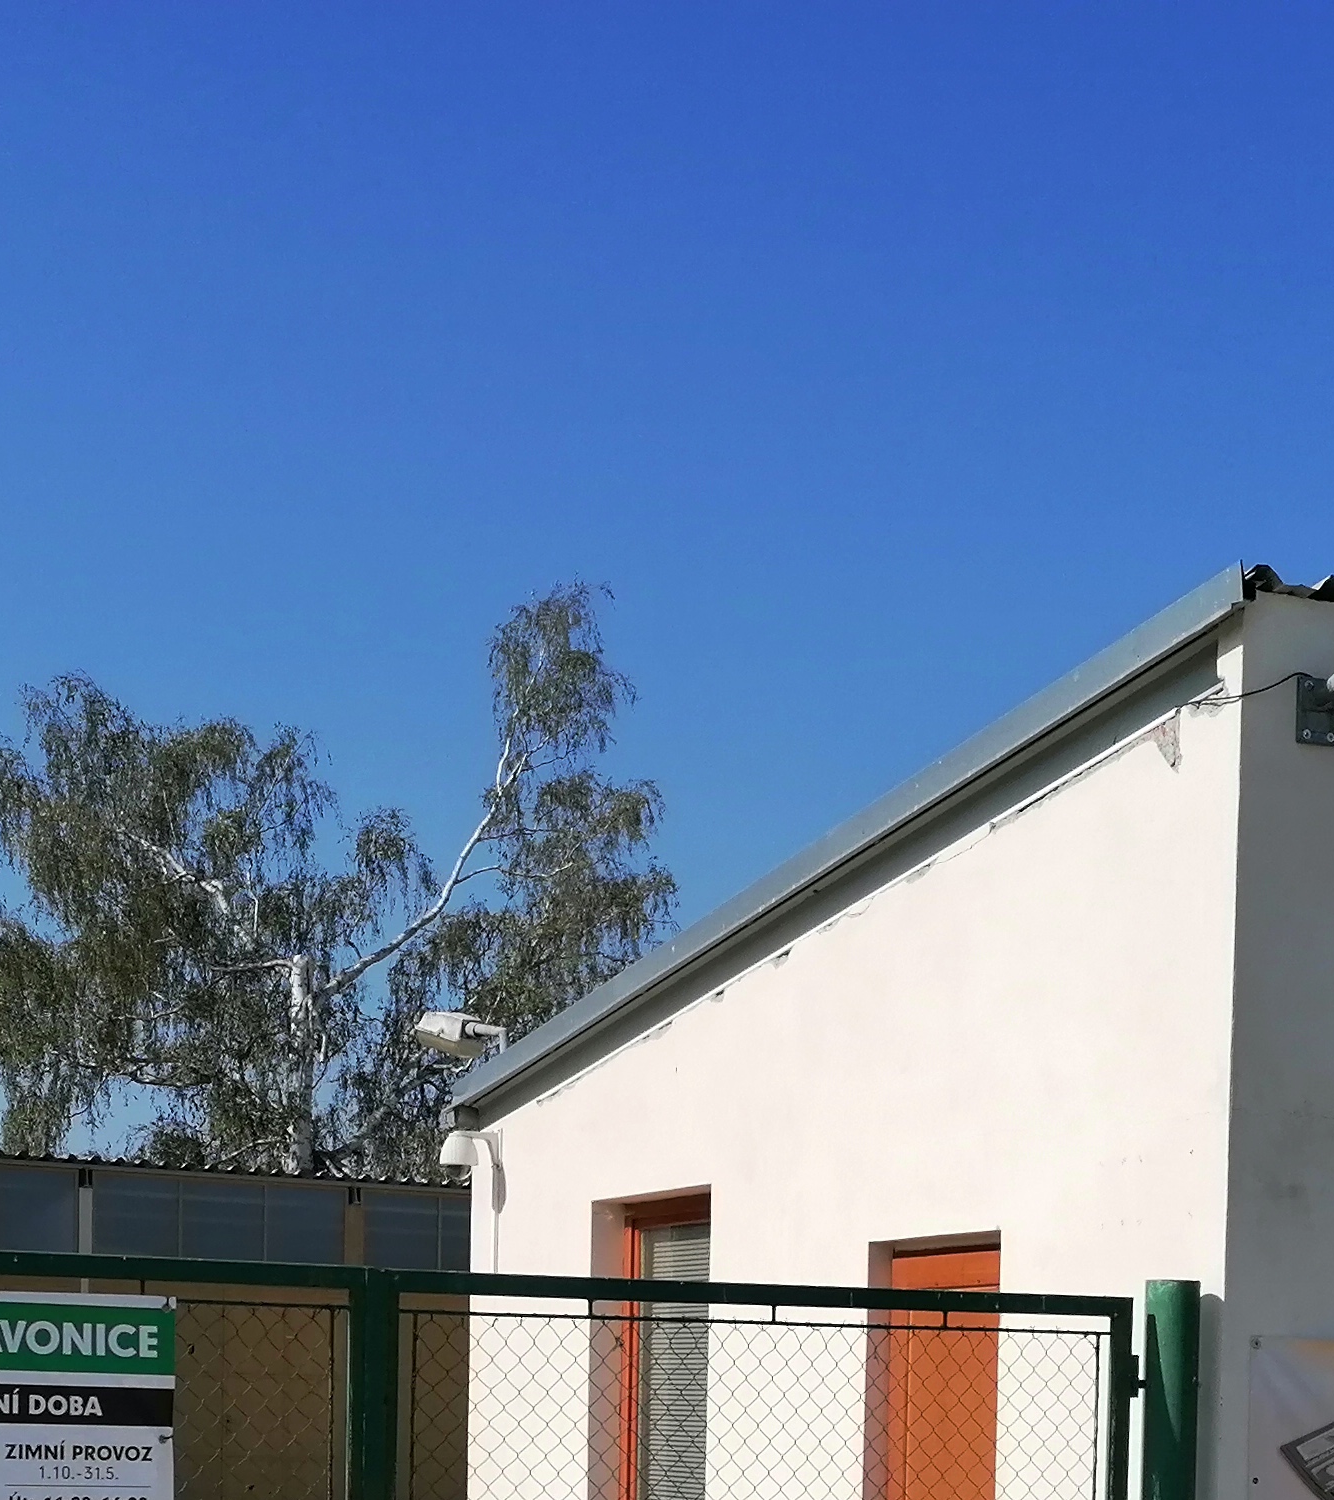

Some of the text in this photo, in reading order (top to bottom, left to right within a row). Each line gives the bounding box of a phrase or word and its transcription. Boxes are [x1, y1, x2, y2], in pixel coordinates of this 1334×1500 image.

[28, 1394, 103, 1416] DOBA
[4, 1440, 153, 1462] ZIMNÍ PROVOZ
